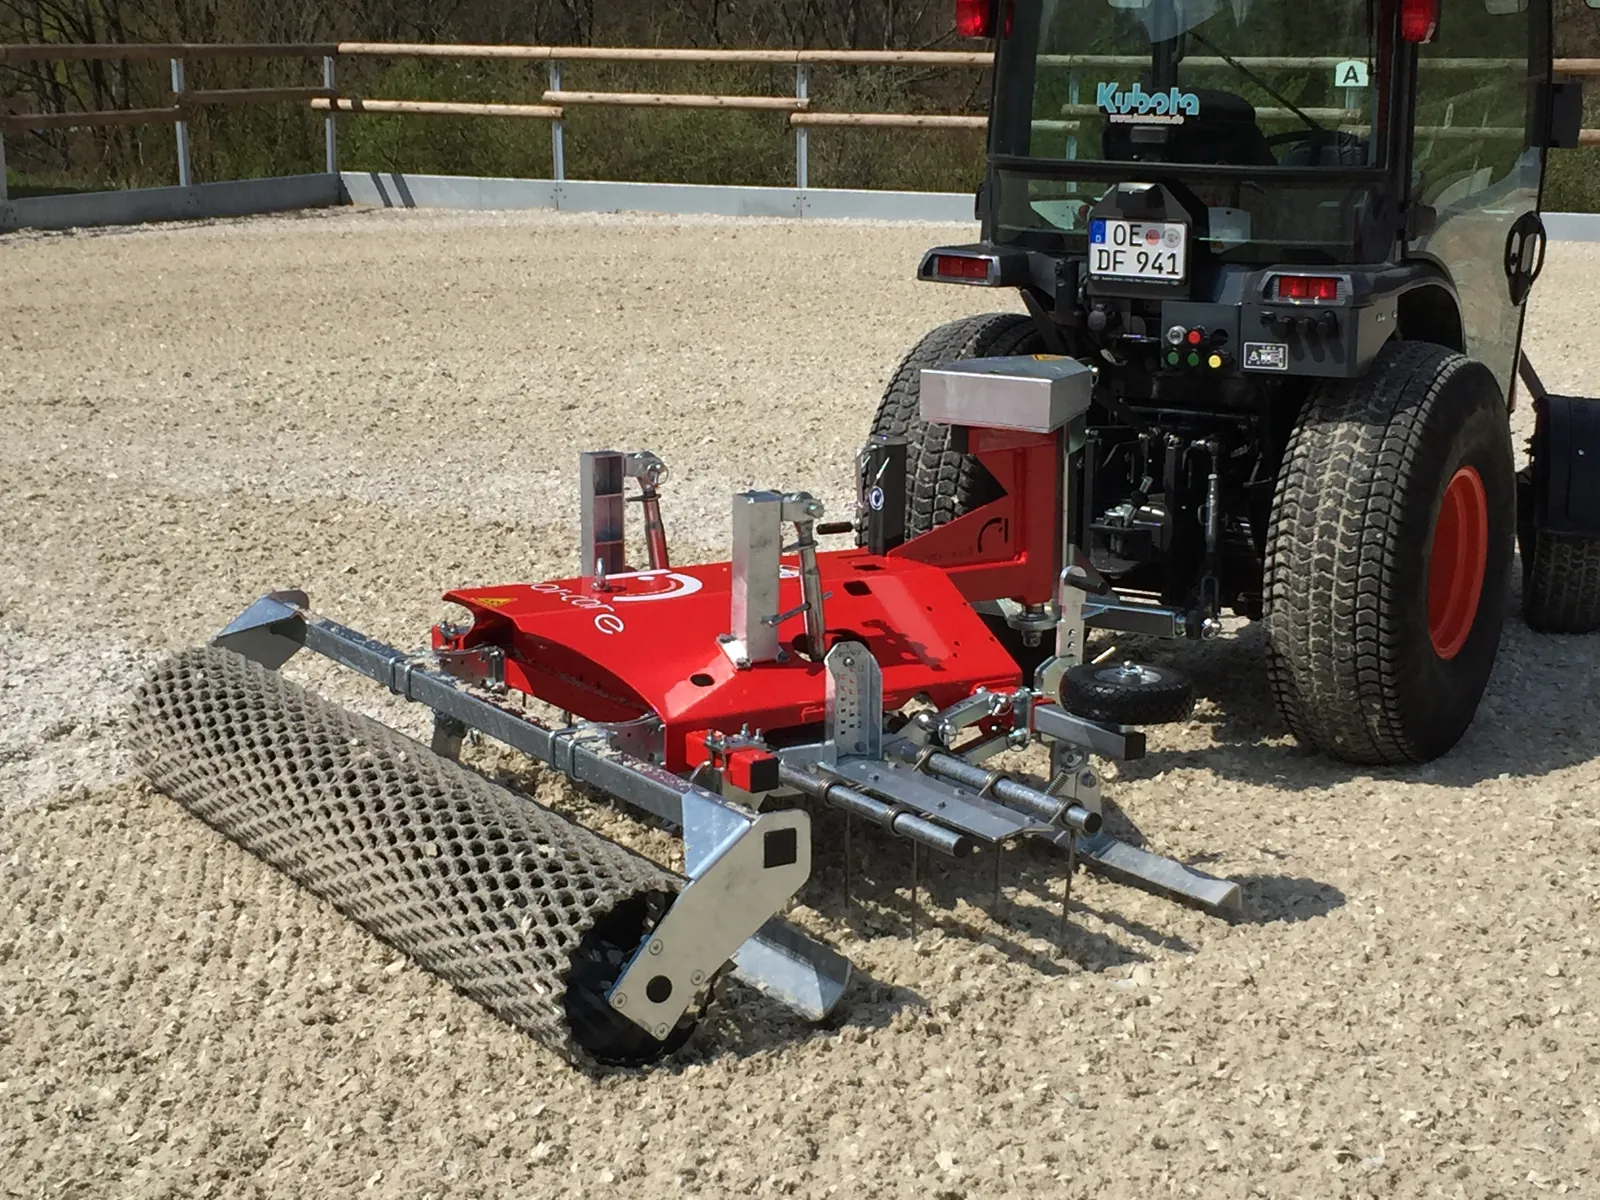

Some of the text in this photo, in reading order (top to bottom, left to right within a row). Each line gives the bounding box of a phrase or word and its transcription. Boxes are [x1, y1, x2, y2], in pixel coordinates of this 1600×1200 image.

[1342, 65, 1360, 83] A
[1096, 82, 1199, 115] Kubota
[1113, 224, 1143, 247] OE
[1096, 249, 1180, 276] DF 941
